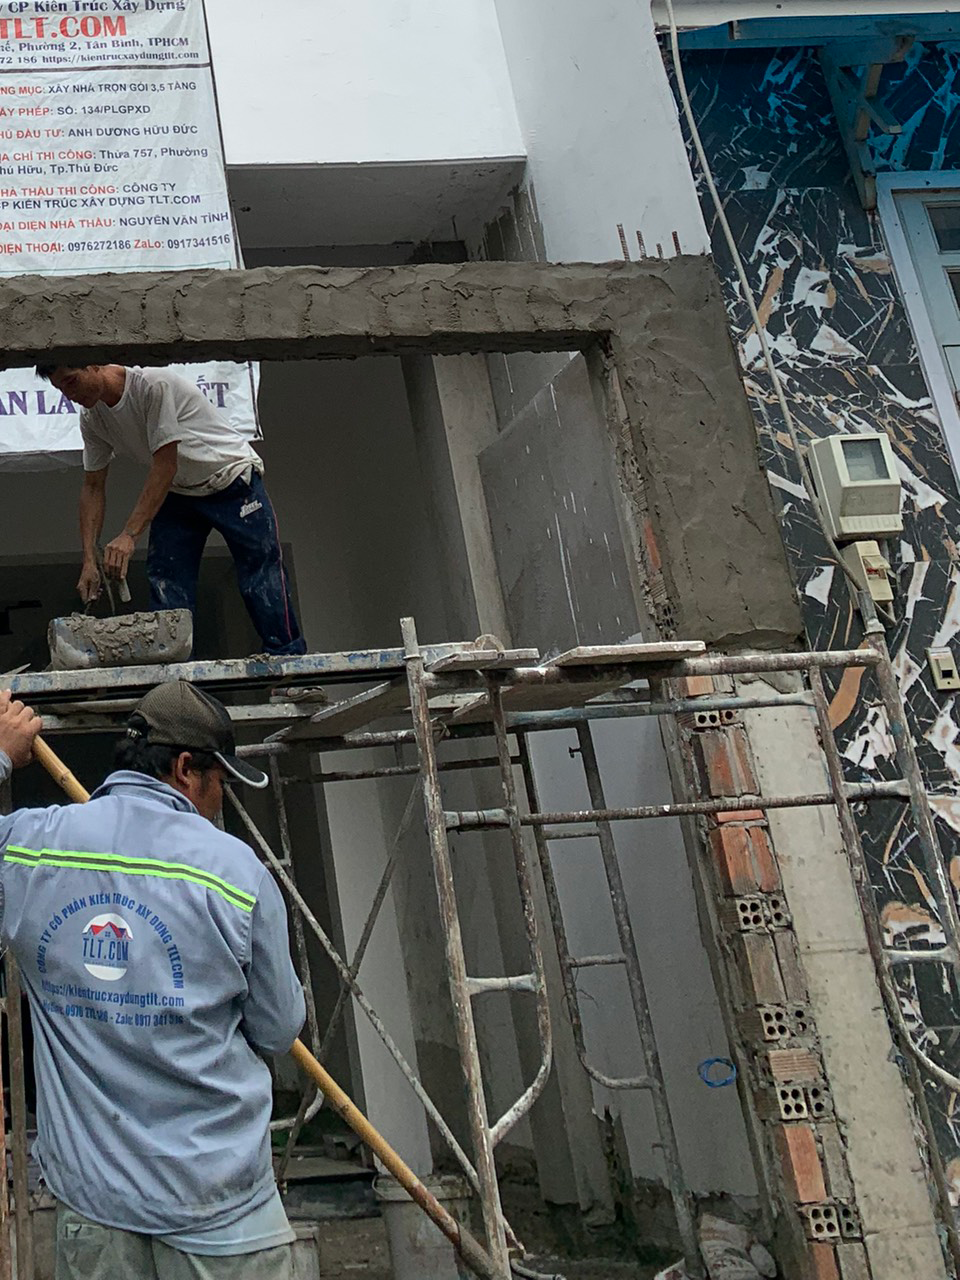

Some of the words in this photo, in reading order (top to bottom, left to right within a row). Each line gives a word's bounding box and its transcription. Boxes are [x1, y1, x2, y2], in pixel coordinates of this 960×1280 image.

[8, 1, 29, 13] CP
[72, 0, 108, 11] Trúc
[112, 0, 140, 13] Xây
[144, 0, 186, 13] Dựng
[18, 41, 66, 52] Phường
[69, 41, 81, 51] 2,
[85, 40, 107, 50] Tân
[147, 37, 189, 47] TPHCM
[18, 56, 38, 64] 186
[18, 85, 46, 96] MỤC:
[48, 83, 70, 94] XÂY
[73, 82, 95, 93] NHÀ
[98, 83, 127, 94] TRỌN
[129, 81, 148, 92] GÓI
[150, 83, 166, 93] 3,5
[18, 105, 54, 116] PHÉP:
[81, 105, 151, 114] 134/PLGPXD
[44, 128, 65, 137] TƯ:
[68, 128, 93, 137] ANH
[96, 127, 140, 137] DƯƠNG
[172, 123, 199, 134] ĐỨC
[36, 151, 55, 160] THI
[58, 149, 96, 160] CÔNG:
[133, 148, 158, 158] 757,
[160, 147, 209, 158] Phường
[94, 163, 119, 173] Đức
[57, 186, 77, 195] THI
[79, 183, 120, 195] CÔNG:
[122, 182, 158, 193] CÔNG
[161, 182, 176, 191] TY
[44, 197, 78, 208] TRÚC
[81, 196, 105, 207] XÂY
[109, 196, 145, 208] DỰNG
[148, 195, 201, 205] TLT.COM
[50, 218, 76, 229] NHÀ
[25, 242, 65, 254] THOẠI:
[67, 240, 131, 252] 0976272186
[134, 239, 165, 249] ZaLo:
[167, 234, 231, 249] 0917341516
[196, 375, 229, 408] ẾT
[40, 929, 52, 943] TY
[83, 937, 129, 961] TLT.COM
